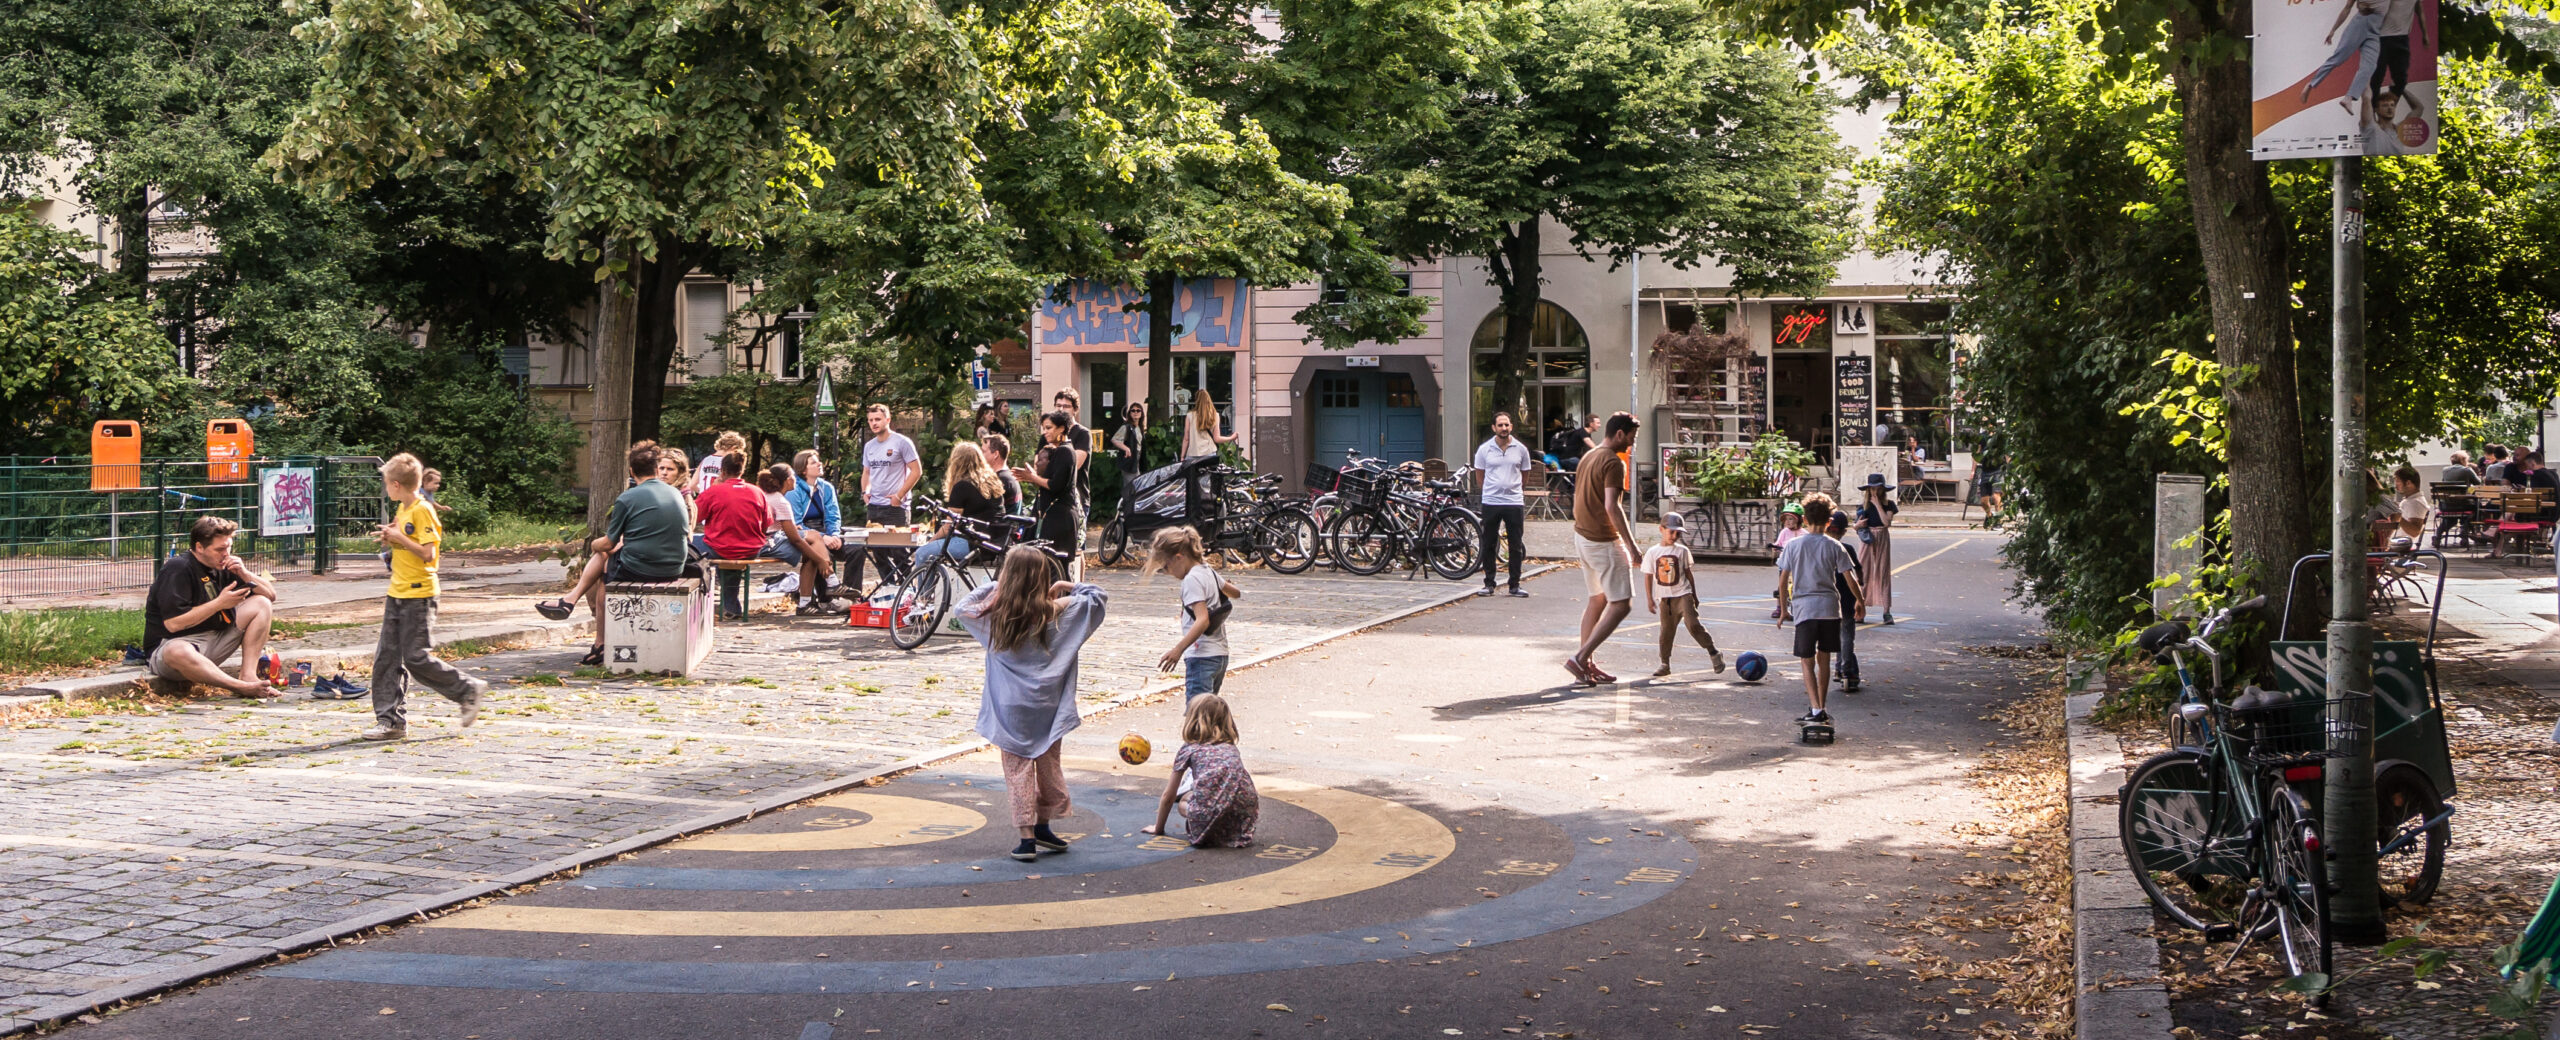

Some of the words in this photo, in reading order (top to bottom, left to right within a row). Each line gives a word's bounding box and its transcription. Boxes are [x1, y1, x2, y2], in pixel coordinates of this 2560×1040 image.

[1042, 299, 1140, 345] SCHÜLER
[1776, 309, 1827, 344] gigi
[1841, 377, 1864, 387] FOOD
[1839, 388, 1864, 396] BRUNCH
[1839, 418, 1869, 427] BOWLS
[803, 817, 862, 827] 50
[1255, 844, 1319, 860] 250
[1624, 867, 1682, 883] 400
